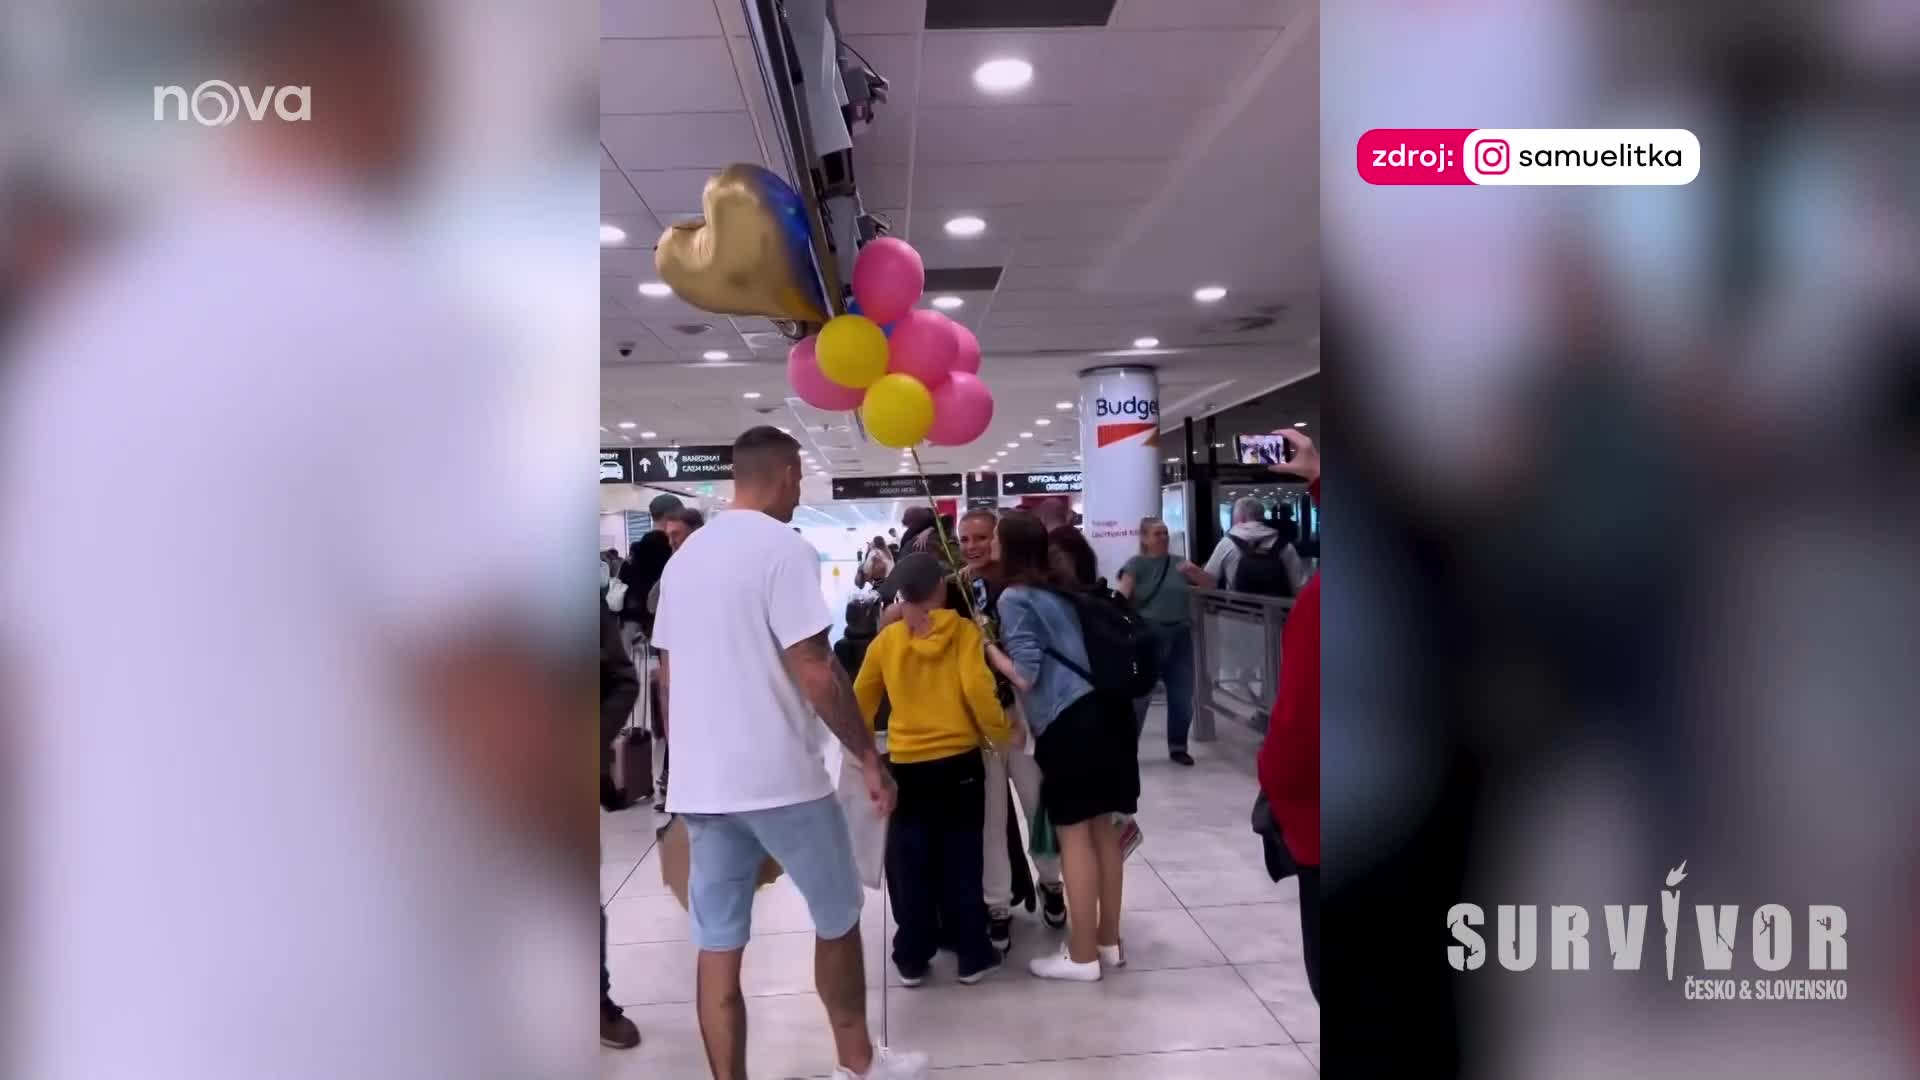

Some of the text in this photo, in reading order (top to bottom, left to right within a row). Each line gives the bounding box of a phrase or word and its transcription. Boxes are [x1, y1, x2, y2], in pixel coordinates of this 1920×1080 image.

[1096, 395, 1159, 420] Budge
[682, 464, 702, 472] CASH
[1028, 473, 1082, 483] OFFICIAL AIRPOR
[1046, 483, 1069, 491] ORDER
